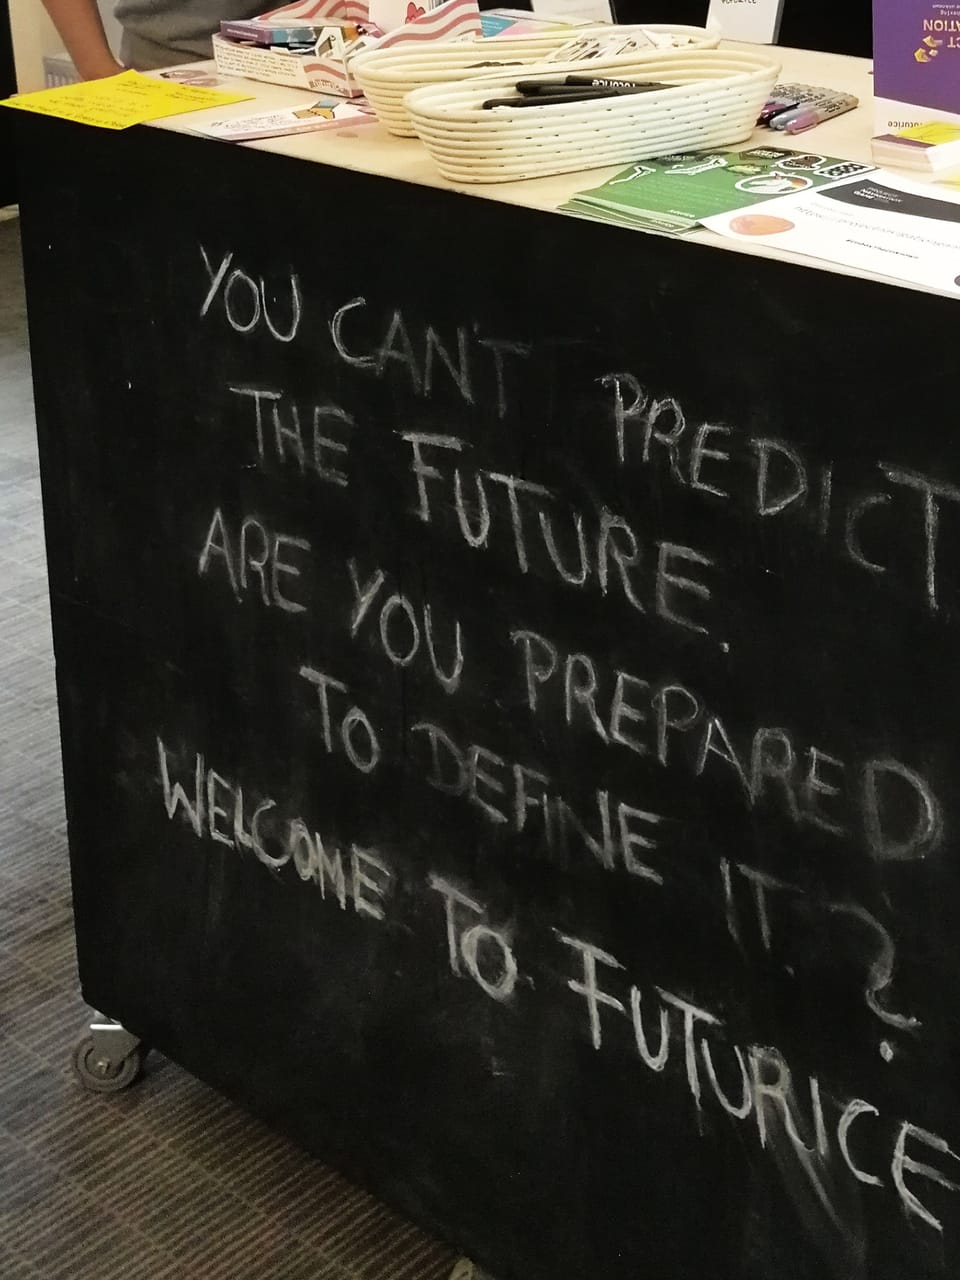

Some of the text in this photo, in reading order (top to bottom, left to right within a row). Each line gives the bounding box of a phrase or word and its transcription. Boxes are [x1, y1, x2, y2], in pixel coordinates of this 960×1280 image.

[200, 244, 300, 341] YOU
[229, 387, 353, 486] THE
[200, 507, 943, 861] ARE YOU PREPARED
[300, 665, 380, 773] TO
[411, 721, 664, 885] DEFINE
[156, 736, 391, 921] WELCOME
[427, 871, 518, 1002] TO
